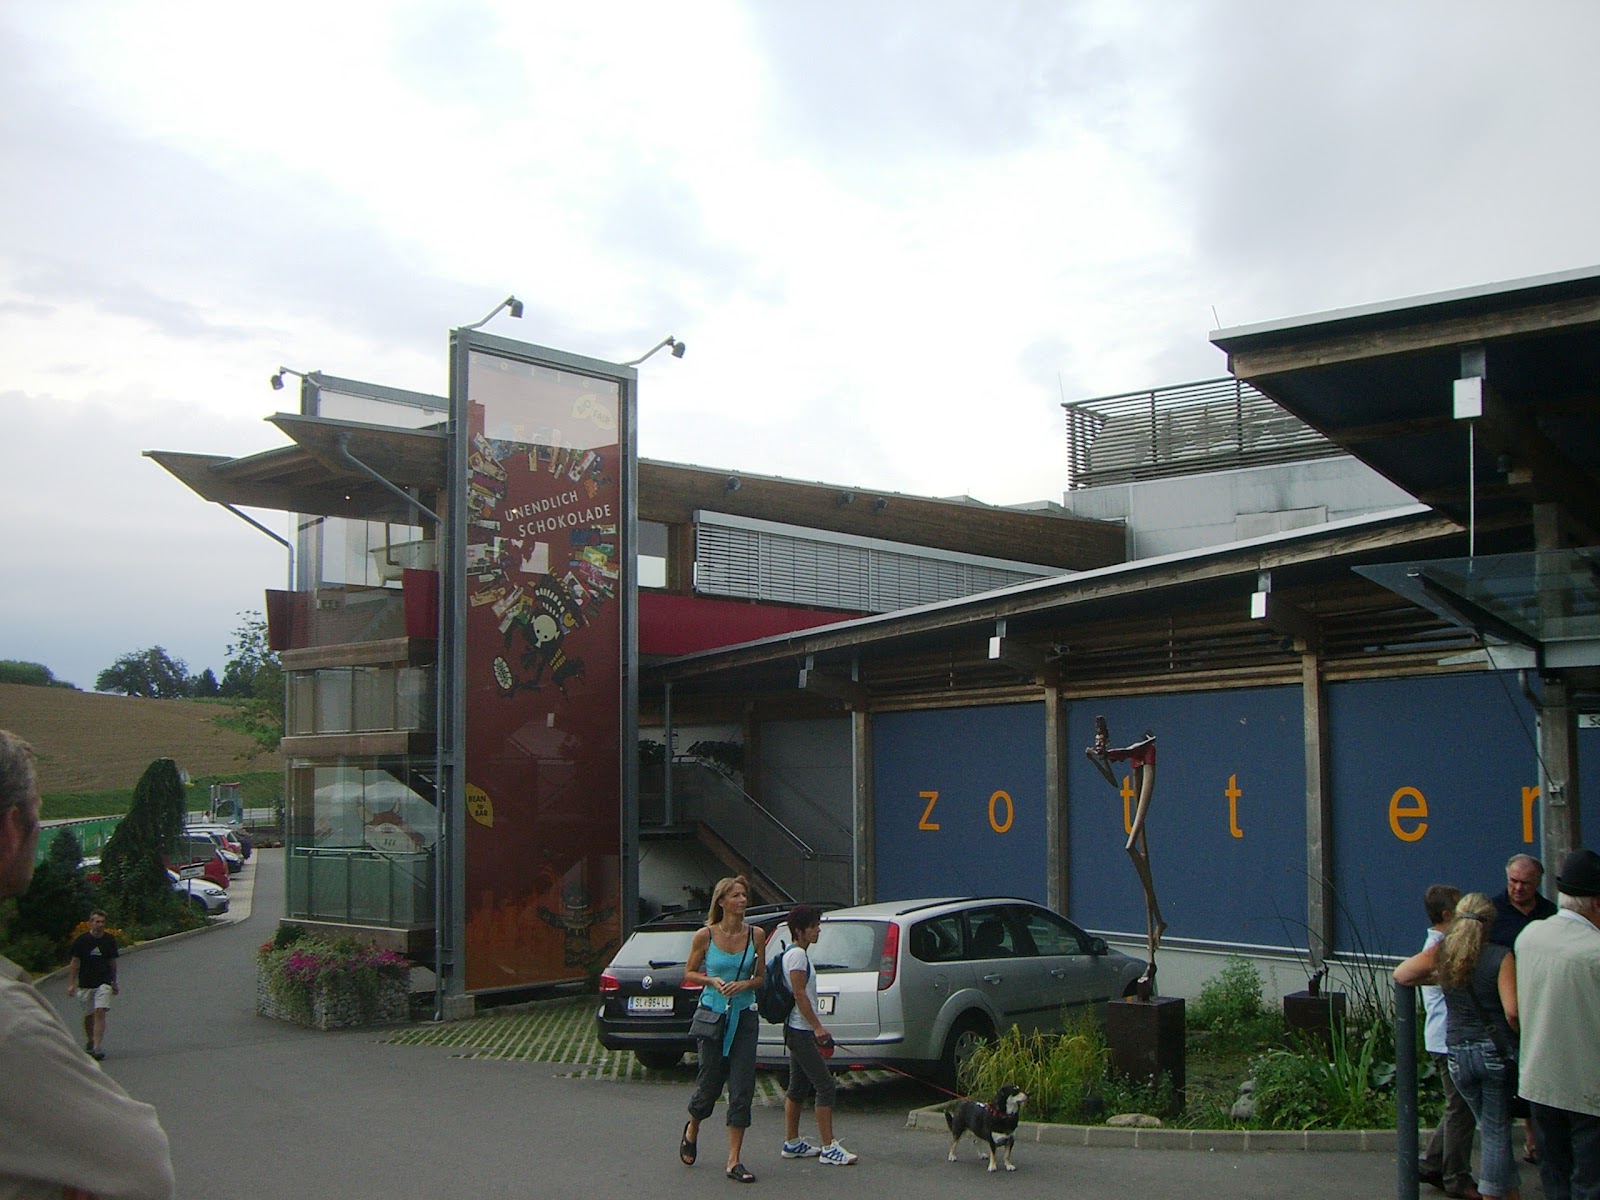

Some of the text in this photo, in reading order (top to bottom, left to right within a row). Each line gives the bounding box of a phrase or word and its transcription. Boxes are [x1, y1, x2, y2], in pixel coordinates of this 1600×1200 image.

[577, 400, 591, 414] BIO
[593, 410, 610, 424] FAIR
[504, 490, 579, 522] UNENDLICH
[518, 504, 612, 538] SCHOKOLADE
[468, 795, 486, 803] BEAN
[475, 809, 488, 817] BAR
